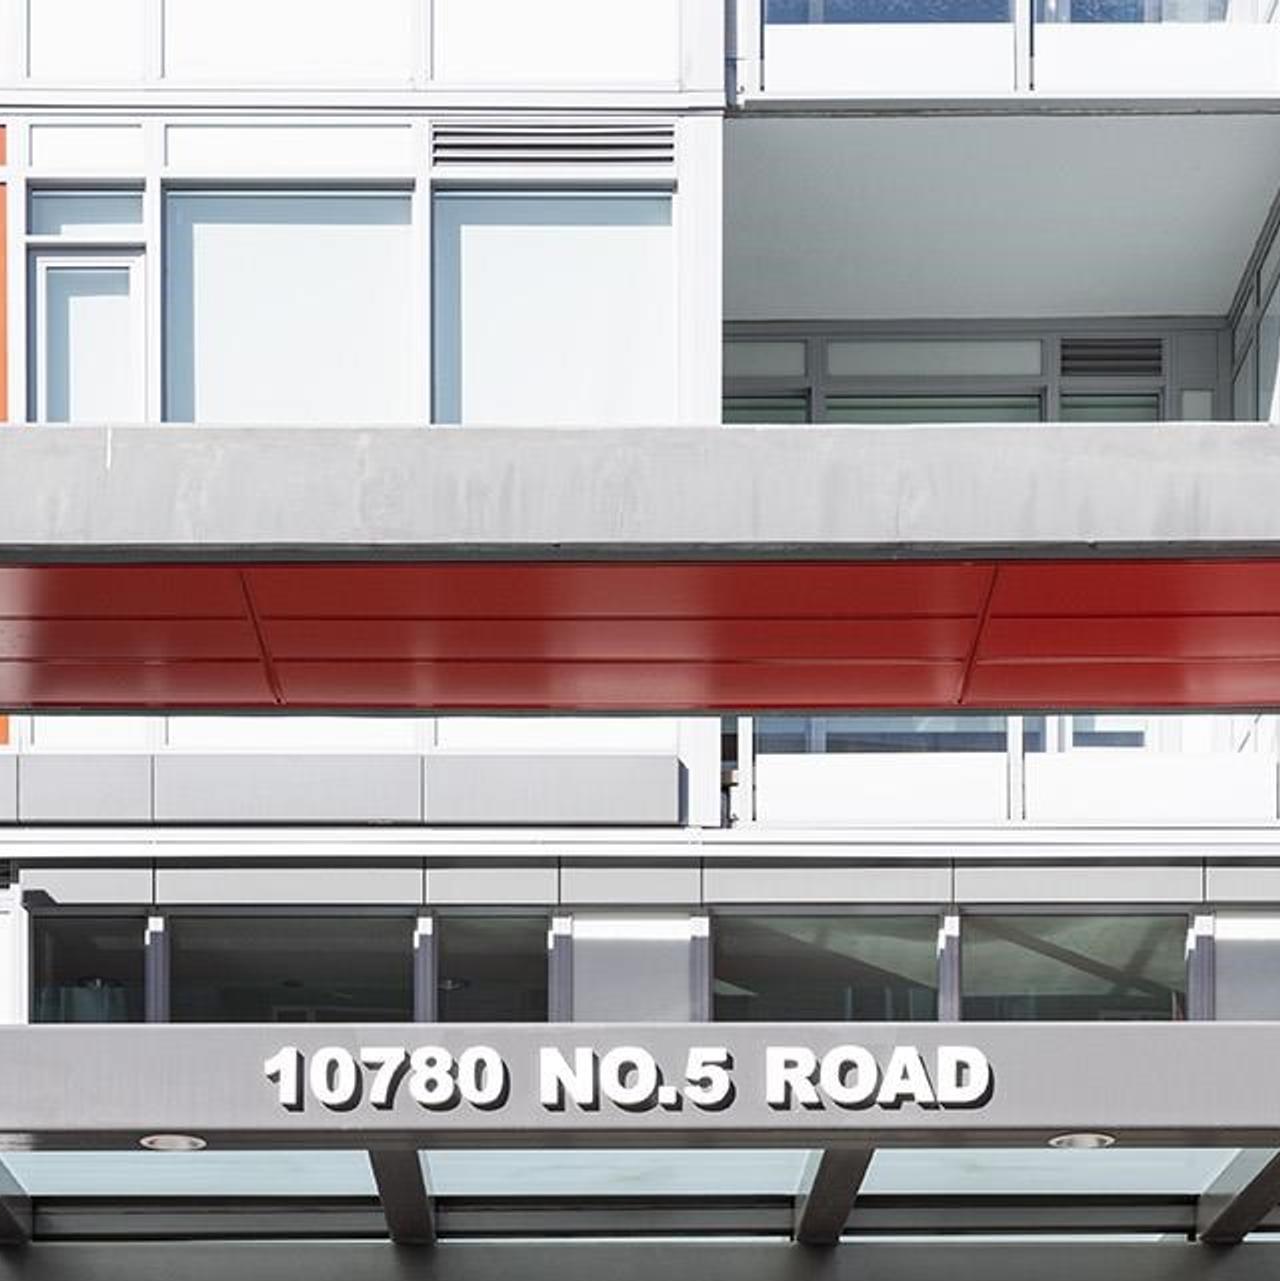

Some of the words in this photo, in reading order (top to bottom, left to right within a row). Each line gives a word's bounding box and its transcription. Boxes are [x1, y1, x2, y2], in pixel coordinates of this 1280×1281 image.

[263, 1045, 509, 1110] 10780
[538, 1045, 736, 1111] NO.5
[764, 1045, 995, 1111] ROAD
